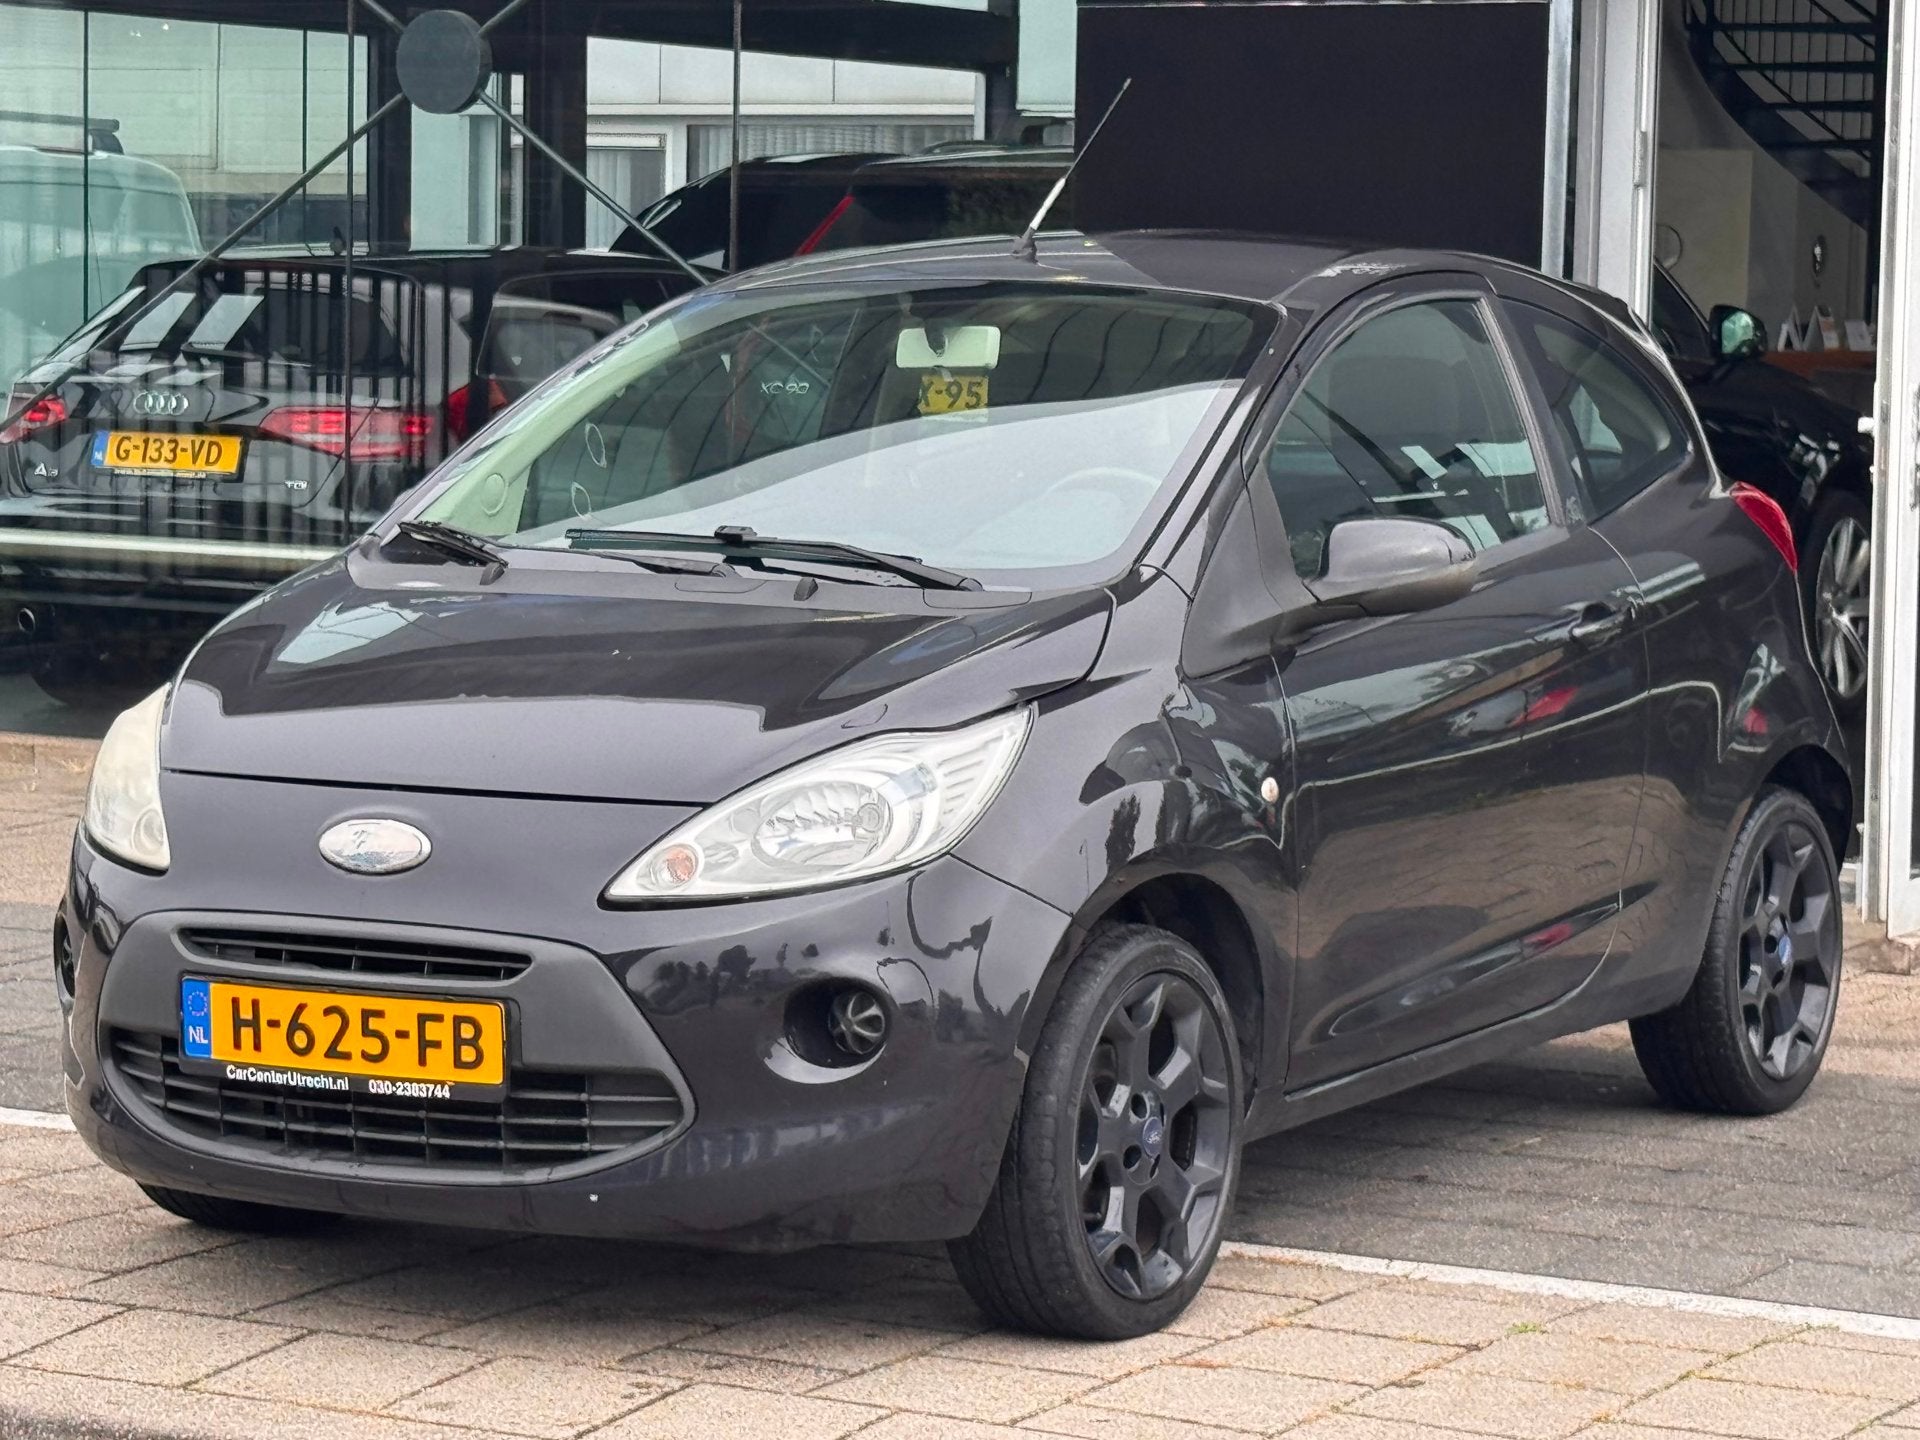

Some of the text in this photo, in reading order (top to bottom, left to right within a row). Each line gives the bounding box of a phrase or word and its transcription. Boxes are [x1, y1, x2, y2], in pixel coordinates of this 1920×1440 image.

[115, 436, 223, 467] G-133-VD
[188, 1025, 209, 1044] NL
[231, 996, 485, 1070] H-625-FB
